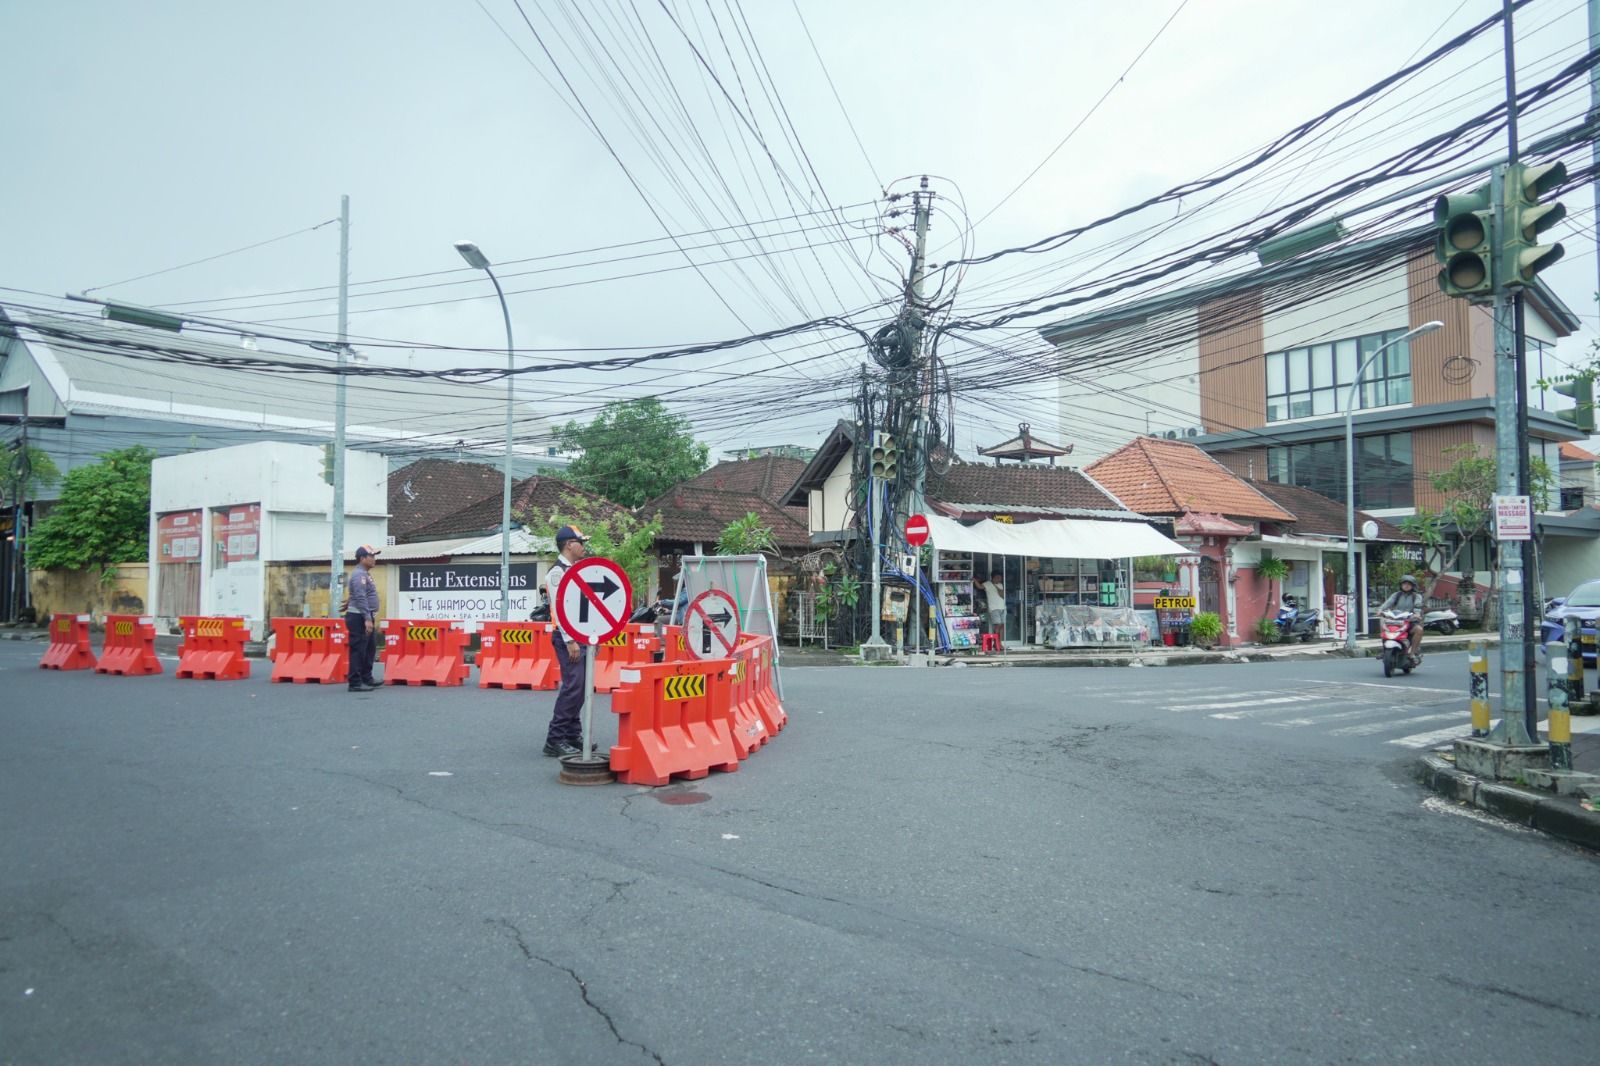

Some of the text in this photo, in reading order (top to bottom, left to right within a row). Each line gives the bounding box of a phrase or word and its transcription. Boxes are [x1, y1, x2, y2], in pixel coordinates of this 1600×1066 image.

[409, 570, 527, 588] Hair Extensins
[418, 596, 527, 611] THE SHAMPOO LONGE
[1155, 598, 1195, 608] PETROL
